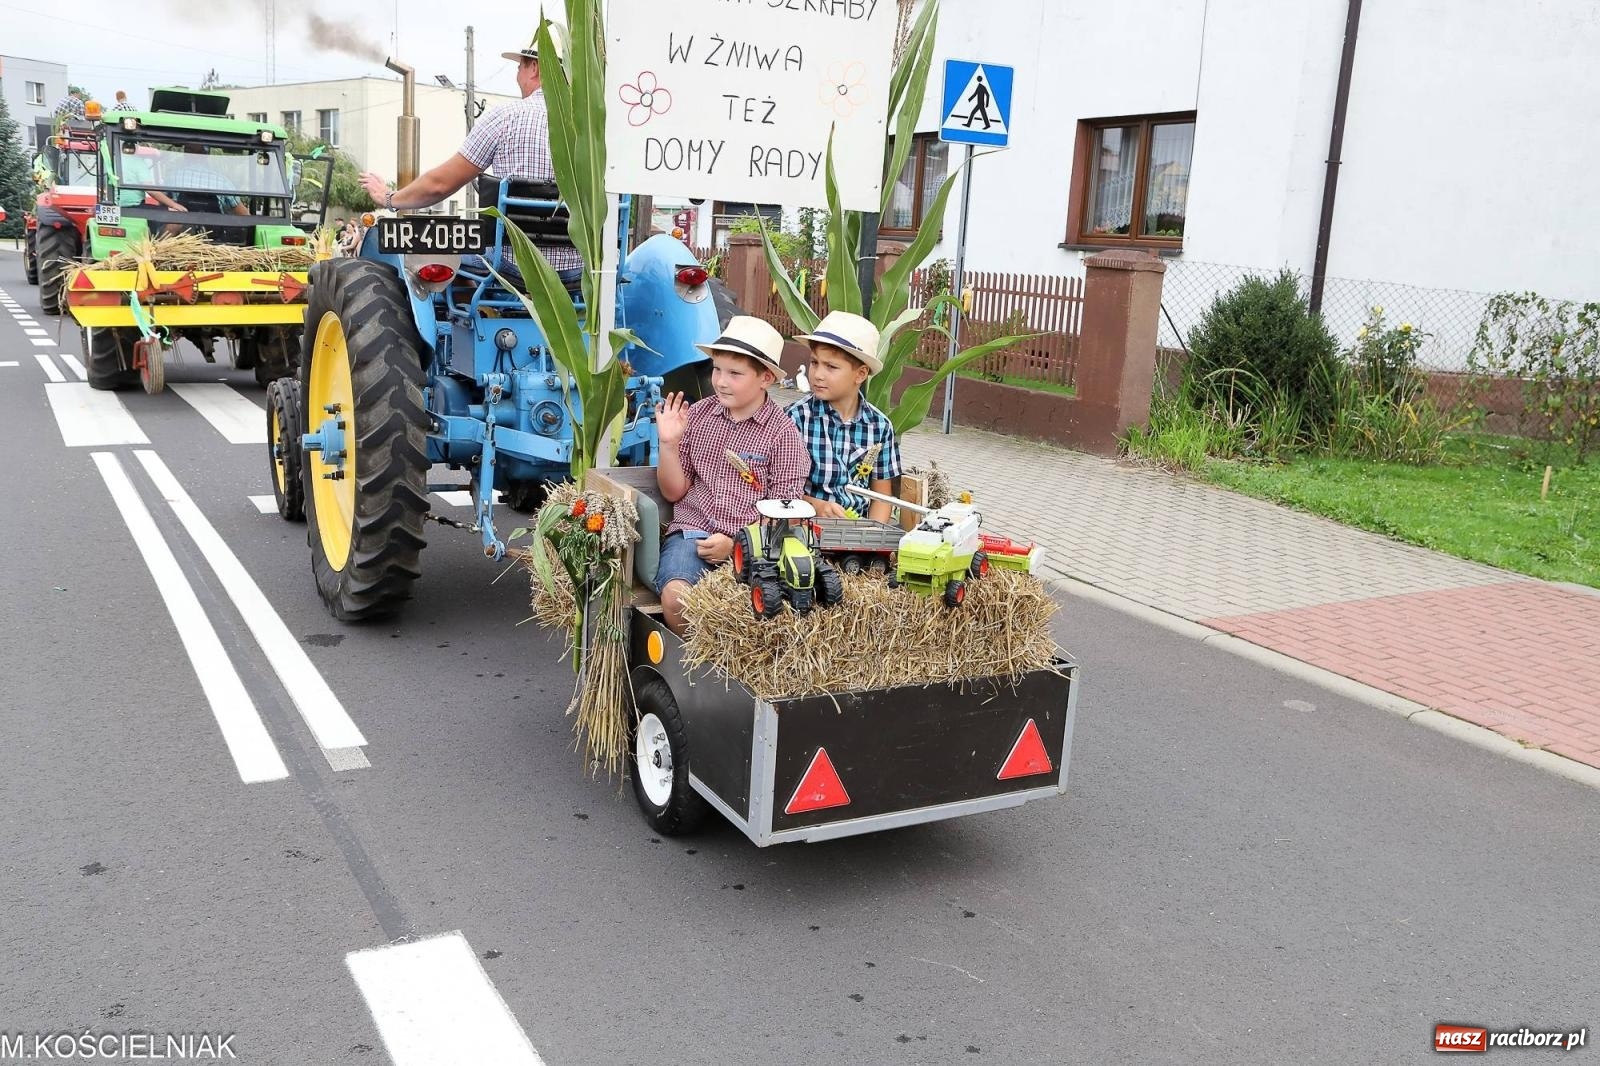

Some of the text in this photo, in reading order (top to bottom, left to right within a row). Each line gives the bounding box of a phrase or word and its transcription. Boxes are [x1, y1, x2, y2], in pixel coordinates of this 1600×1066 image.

[767, 0, 878, 21] RABY
[669, 32, 803, 71] W ŻNIWA
[722, 95, 776, 125] TEŻ
[645, 137, 822, 180] DOMY RADY
